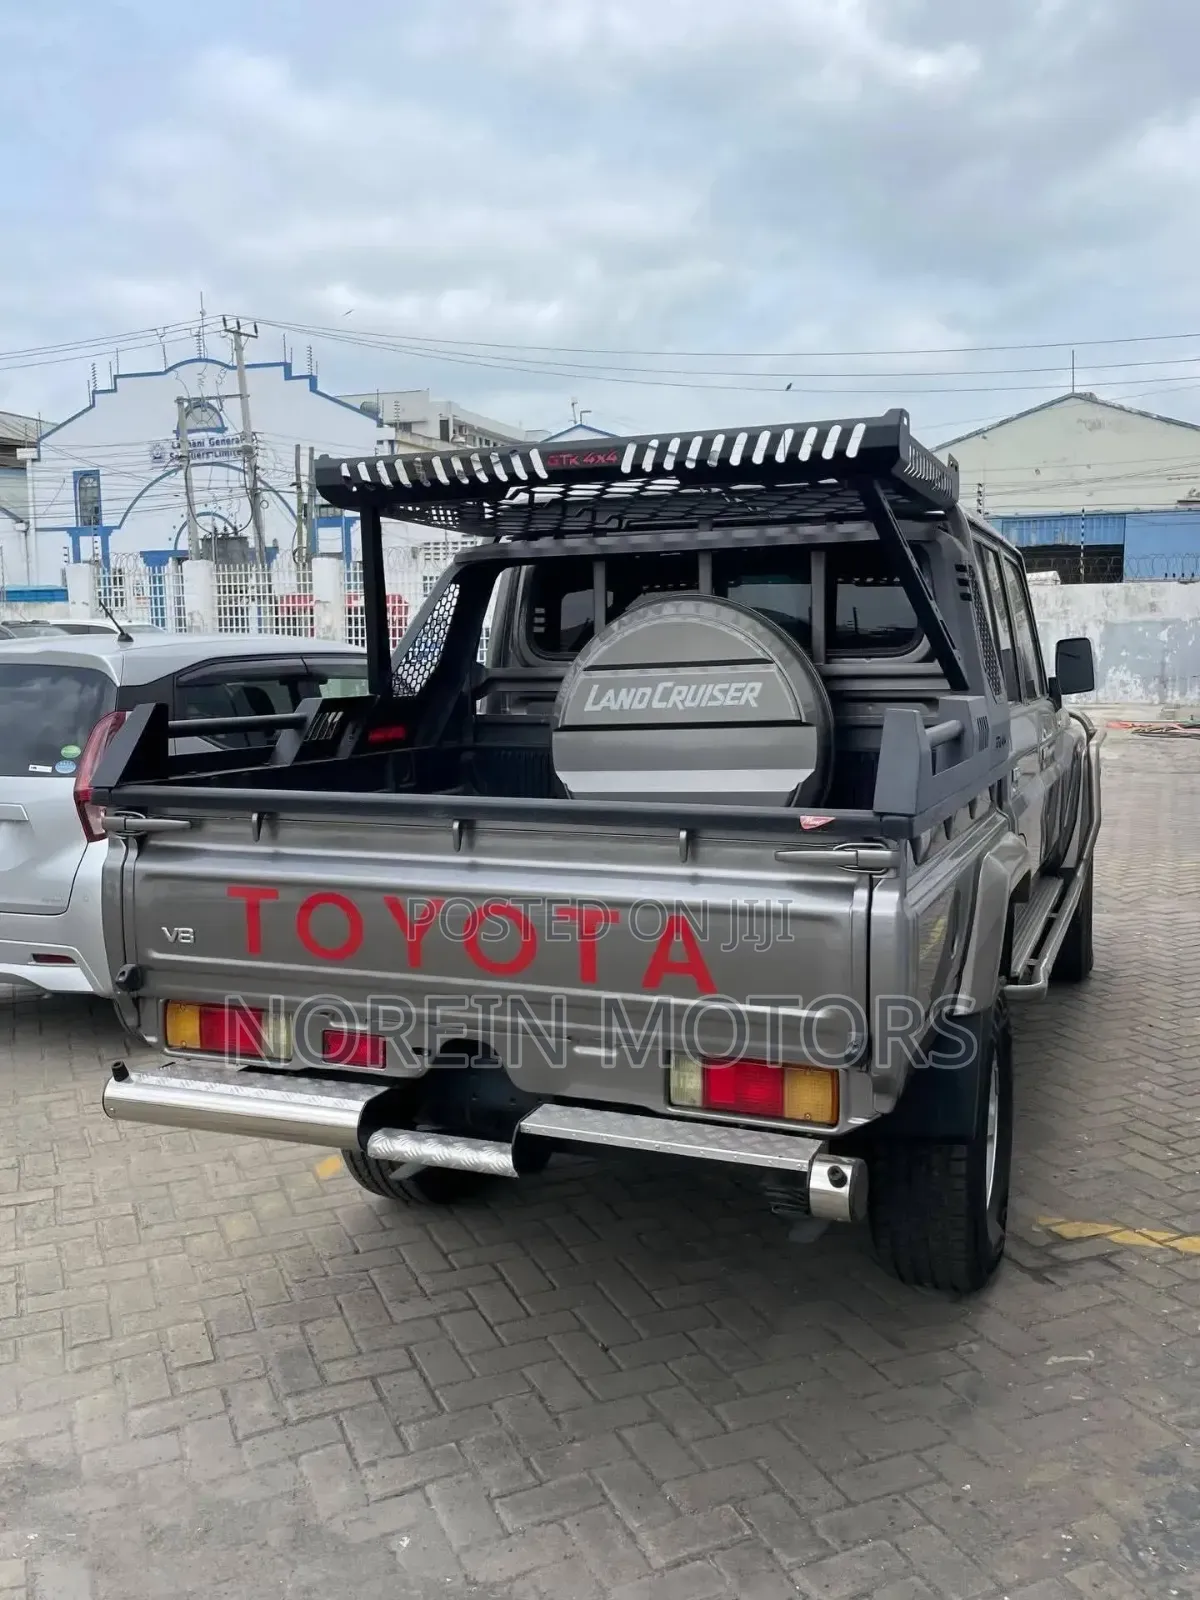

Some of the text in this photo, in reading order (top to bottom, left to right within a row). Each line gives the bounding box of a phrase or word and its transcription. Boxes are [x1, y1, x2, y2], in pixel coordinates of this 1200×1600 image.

[171, 440, 205, 449] Lahani
[214, 449, 246, 458] Limite
[161, 926, 195, 944] V8
[226, 885, 717, 994] TOYOTA
